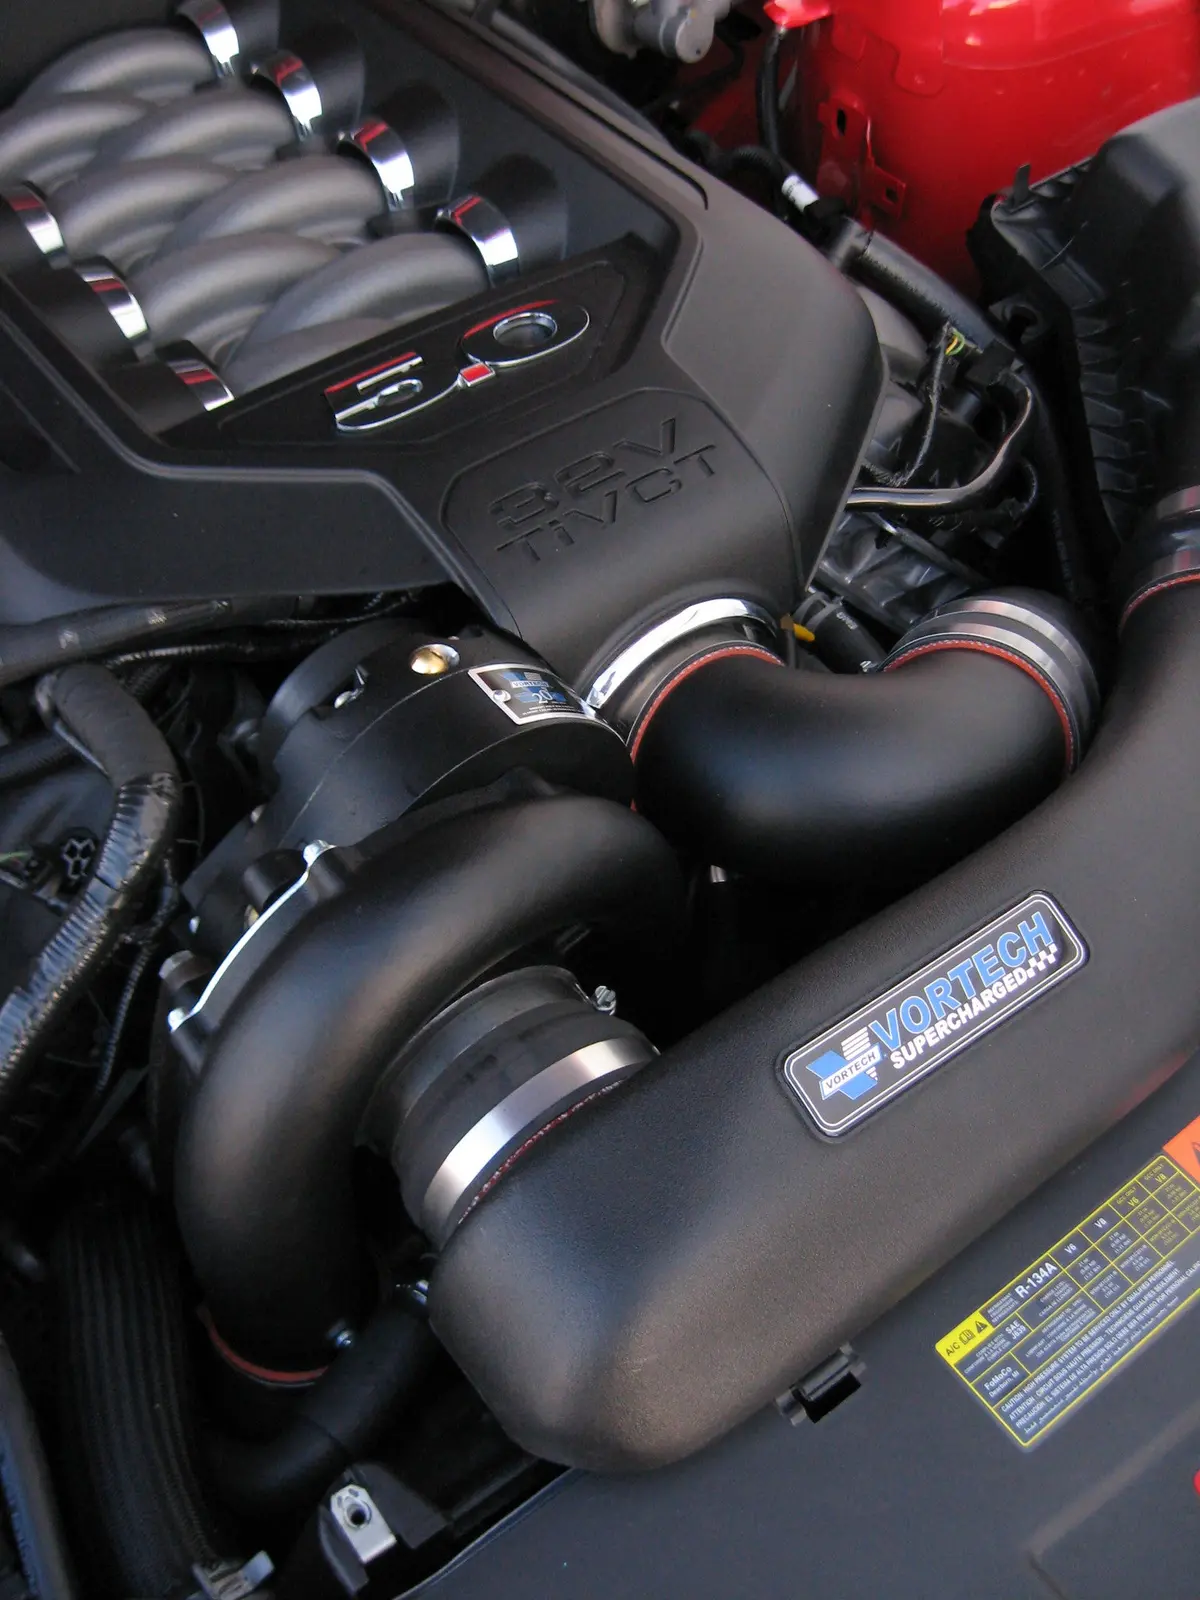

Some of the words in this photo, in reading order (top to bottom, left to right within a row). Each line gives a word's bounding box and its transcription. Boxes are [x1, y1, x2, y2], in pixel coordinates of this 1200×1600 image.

[868, 910, 1055, 1052] VORTECH
[889, 965, 1029, 1070] SUPERCHARGED
[825, 1050, 877, 1090] VORTECH
[1127, 1196, 1139, 1207] V6
[1095, 1217, 1107, 1229] V8
[1064, 1242, 1077, 1254] V6
[1015, 1260, 1057, 1298] R-134A
[1005, 1320, 1020, 1334] SAE
[1010, 1324, 1026, 1339] J639
[1022, 1380, 1036, 1393] HIGH
[1033, 1360, 1059, 1384] PRESSURE
[1056, 1345, 1077, 1363] SYSTEM
[1074, 1339, 1083, 1347] TO
[1081, 1334, 1090, 1342] BE
[1088, 1315, 1111, 1336] SERVICED
[1109, 1305, 1122, 1318] ONLY
[1120, 1299, 1129, 1308] BY
[1126, 1281, 1150, 1302] QUALIFIED
[1147, 1260, 1174, 1283] PERSONNEL
[1044, 1394, 1053, 1402] EL
[1050, 1377, 1072, 1397] SISTEMA
[1069, 1372, 1077, 1380] DE
[1075, 1362, 1089, 1375] ALTA
[1126, 1318, 1139, 1329] SER
[1155, 1292, 1167, 1302] POR
[1164, 1273, 1188, 1295] PERSONAL
[944, 1342, 960, 1356] A/C
[984, 1365, 1012, 1390] FoMoCo
[1011, 1369, 1020, 1378] MI
[1035, 1378, 1055, 1397] CIRCUIT
[1052, 1367, 1068, 1381] SOUS
[1065, 1354, 1083, 1370] HAUTE
[1080, 1335, 1104, 1357] PRESSION
